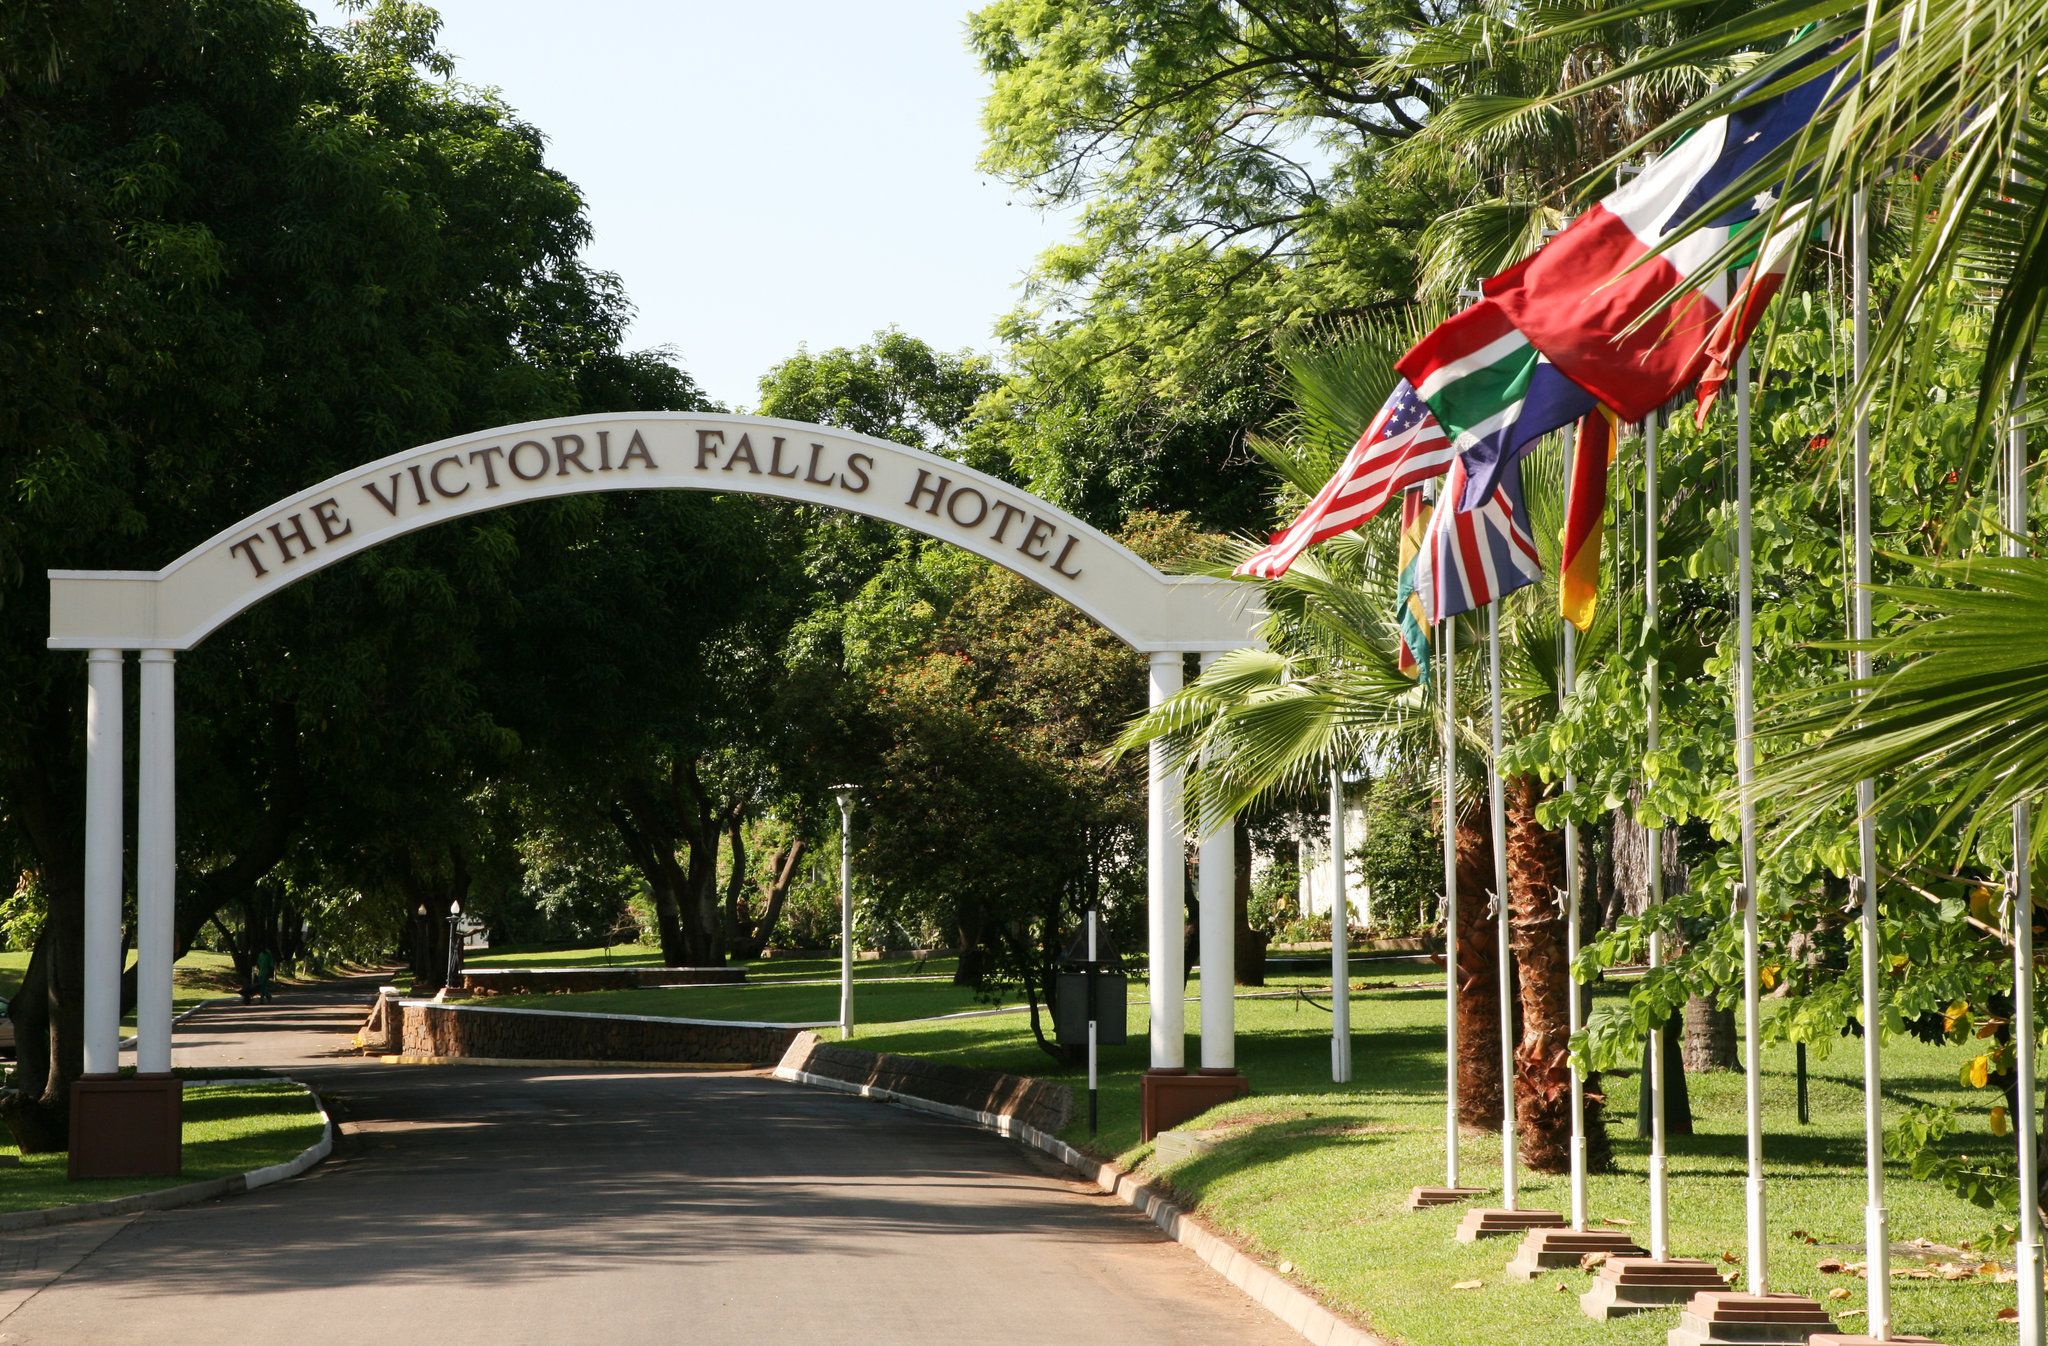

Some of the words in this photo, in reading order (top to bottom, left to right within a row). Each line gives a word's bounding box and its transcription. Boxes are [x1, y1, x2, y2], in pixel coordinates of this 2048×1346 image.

[230, 497, 352, 578] THE
[361, 428, 658, 517] VICTORIA
[694, 429, 874, 494] FALLS
[904, 468, 1083, 580] HOTEL
